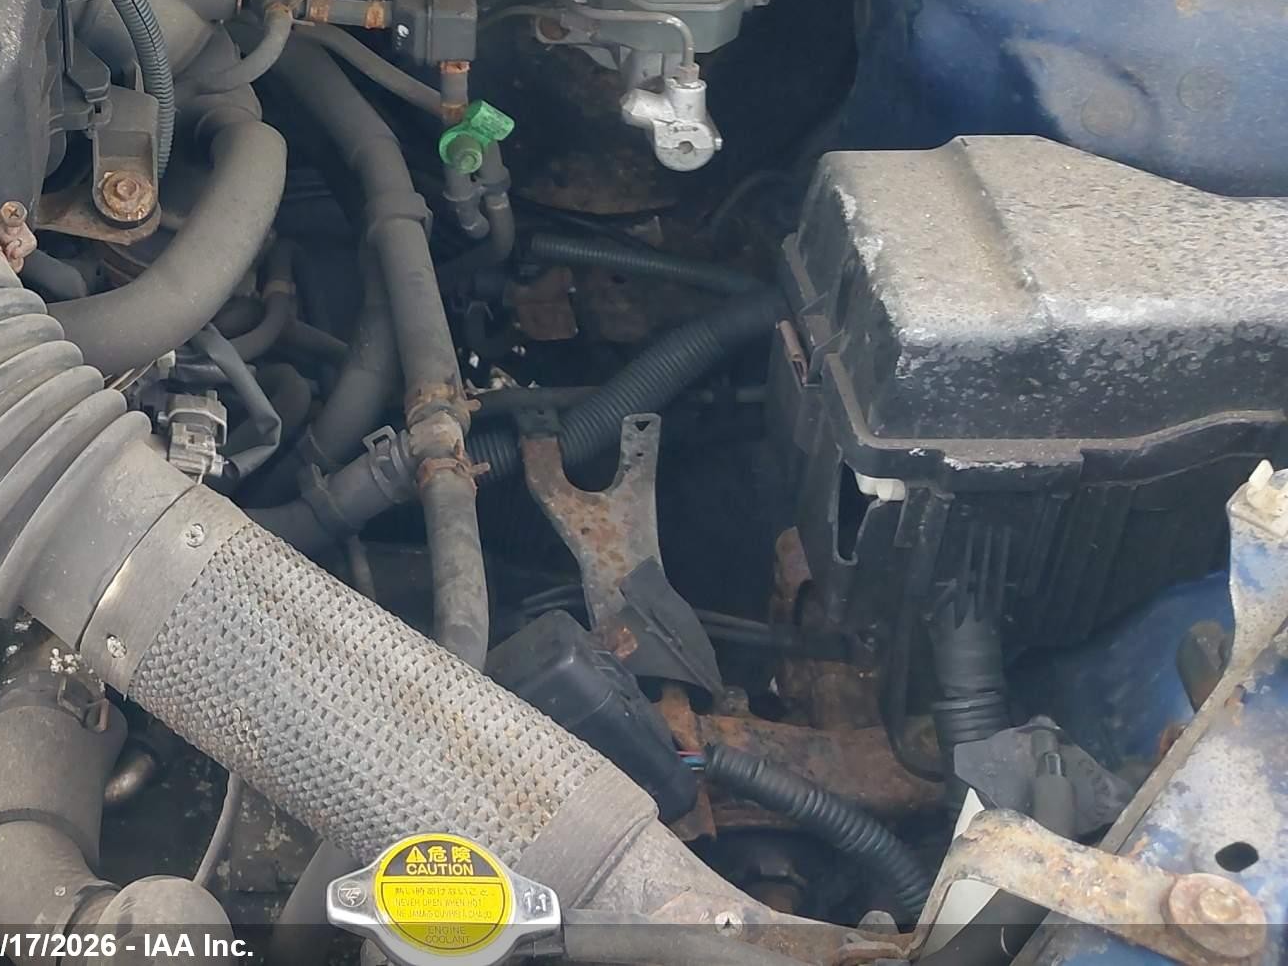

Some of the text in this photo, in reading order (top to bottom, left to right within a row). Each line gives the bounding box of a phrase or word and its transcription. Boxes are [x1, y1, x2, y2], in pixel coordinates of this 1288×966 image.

[428, 846, 472, 863] 危険
[406, 863, 474, 876] CAUTION
[428, 926, 465, 935] ENGINE
[425, 935, 469, 944] COOLANT
